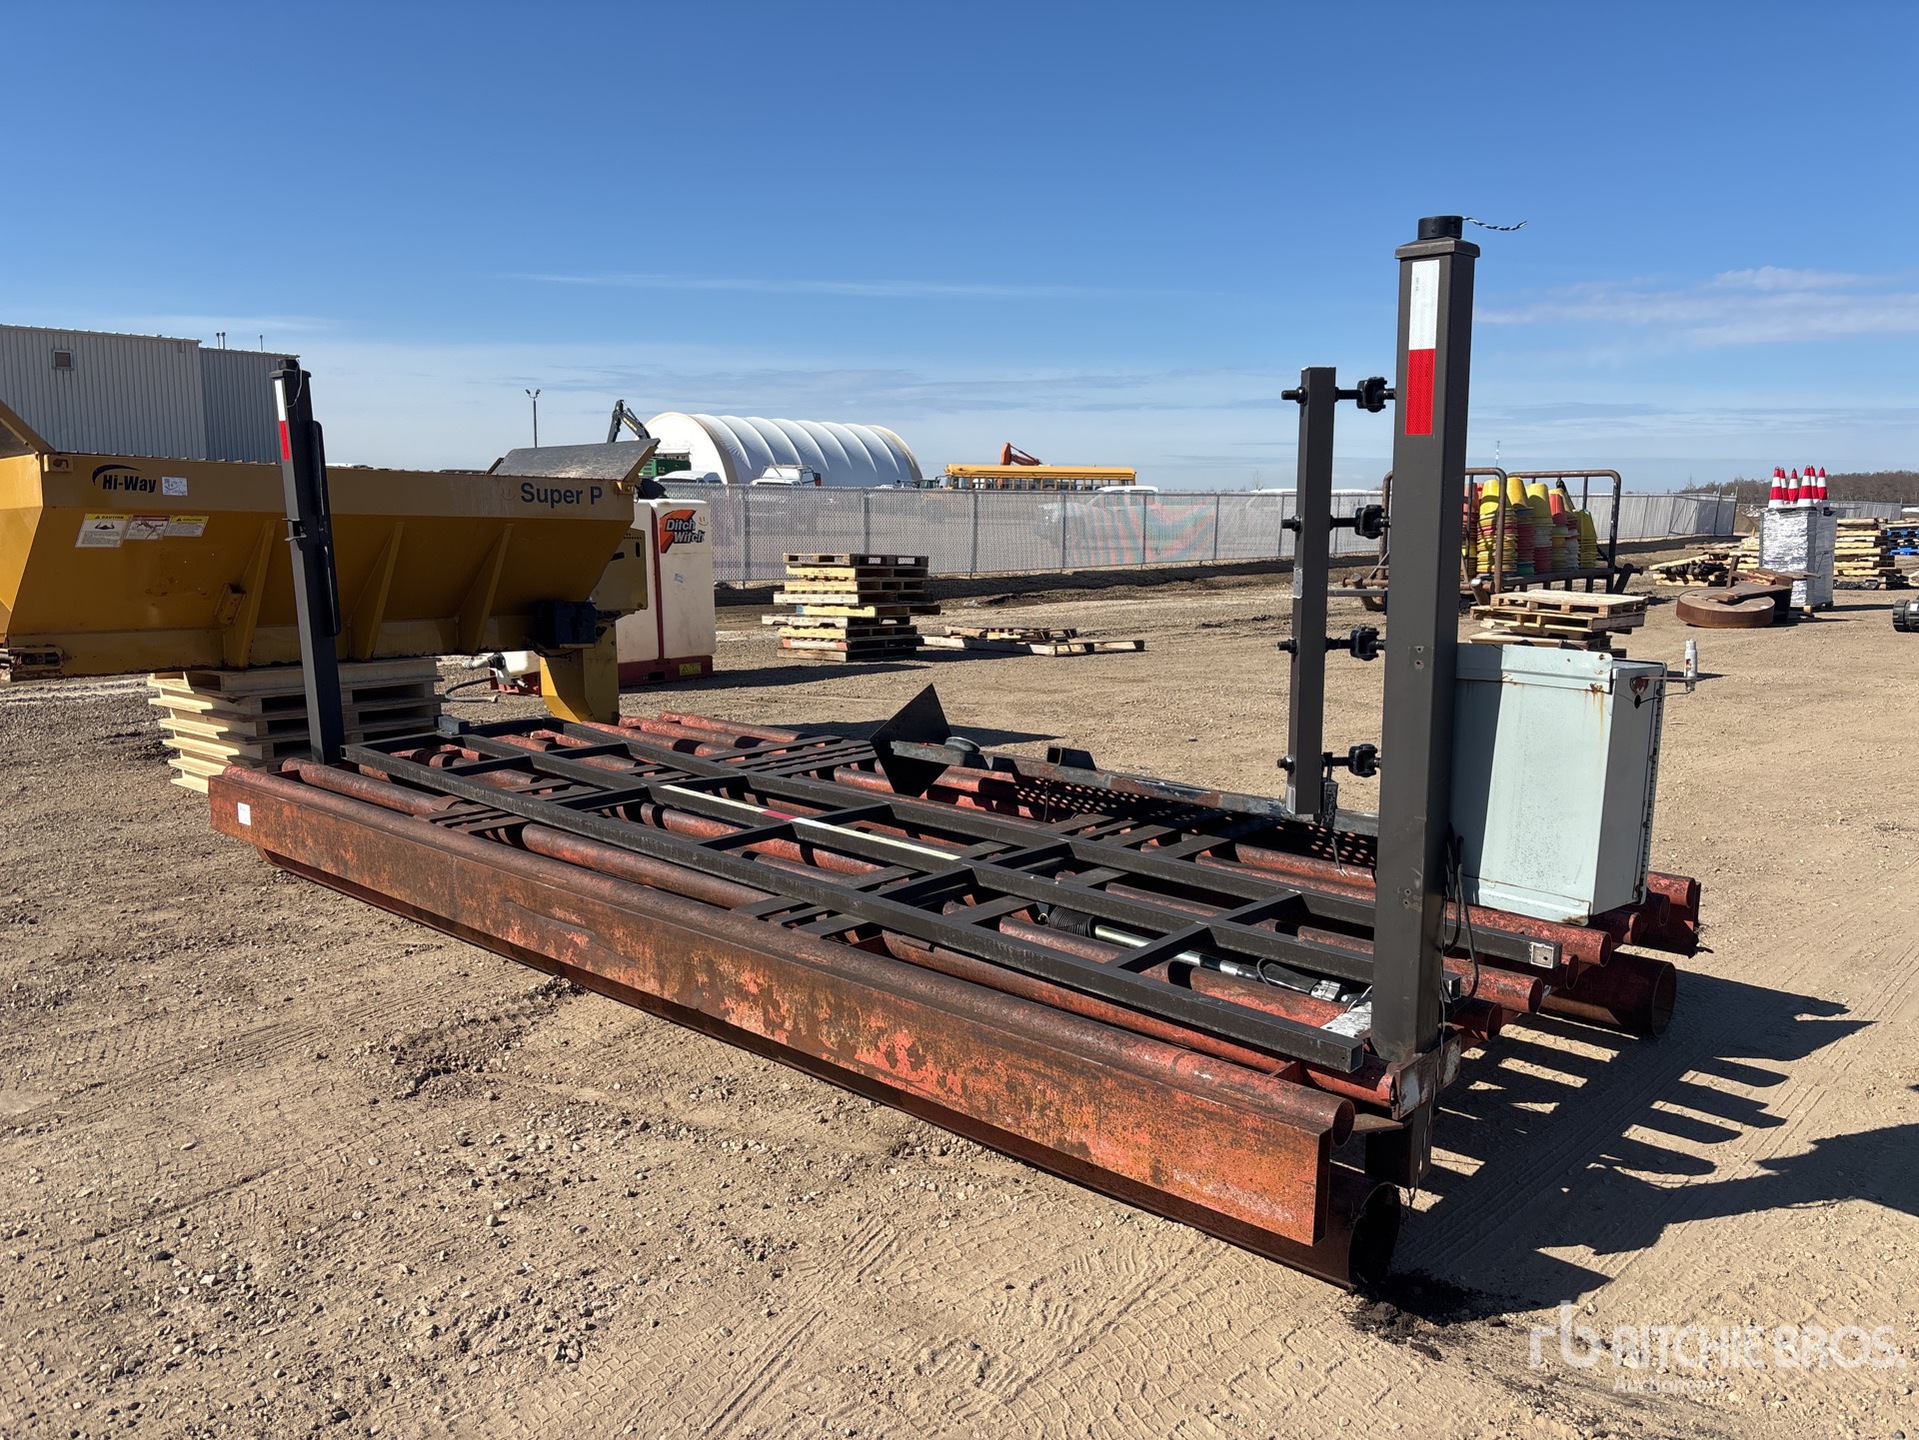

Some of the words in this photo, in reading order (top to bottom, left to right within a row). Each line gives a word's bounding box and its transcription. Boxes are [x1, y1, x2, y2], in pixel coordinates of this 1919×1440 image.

[102, 474, 157, 494] Hi-Way
[520, 482, 584, 509] Super
[590, 486, 602, 505] P
[666, 517, 697, 531] Ditch
[674, 530, 705, 544] Witch
